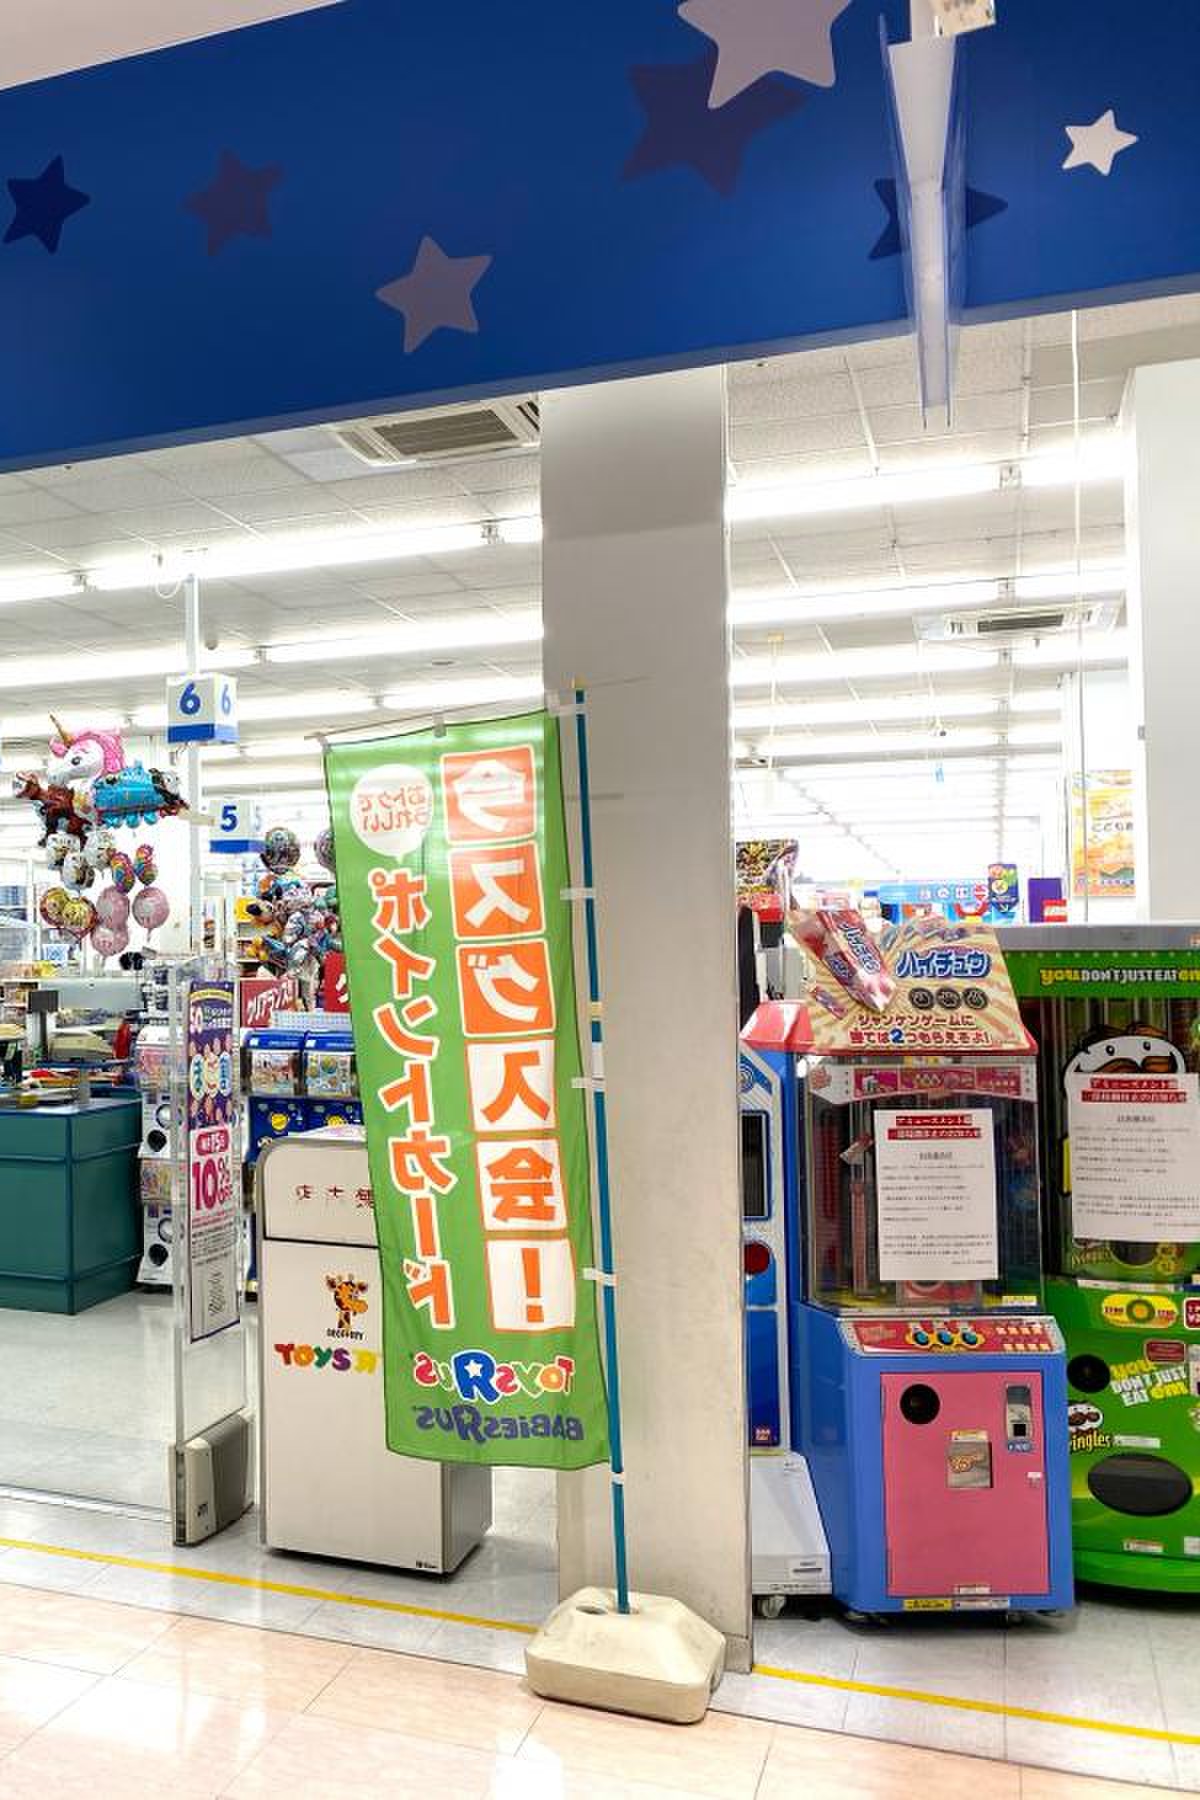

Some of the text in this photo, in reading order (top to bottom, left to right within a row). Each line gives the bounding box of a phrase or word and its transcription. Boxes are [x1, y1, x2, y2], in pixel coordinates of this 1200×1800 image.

[180, 682, 201, 715] 6
[221, 684, 232, 716] 6
[220, 805, 237, 832] 5
[895, 950, 992, 978] ハイチュウ
